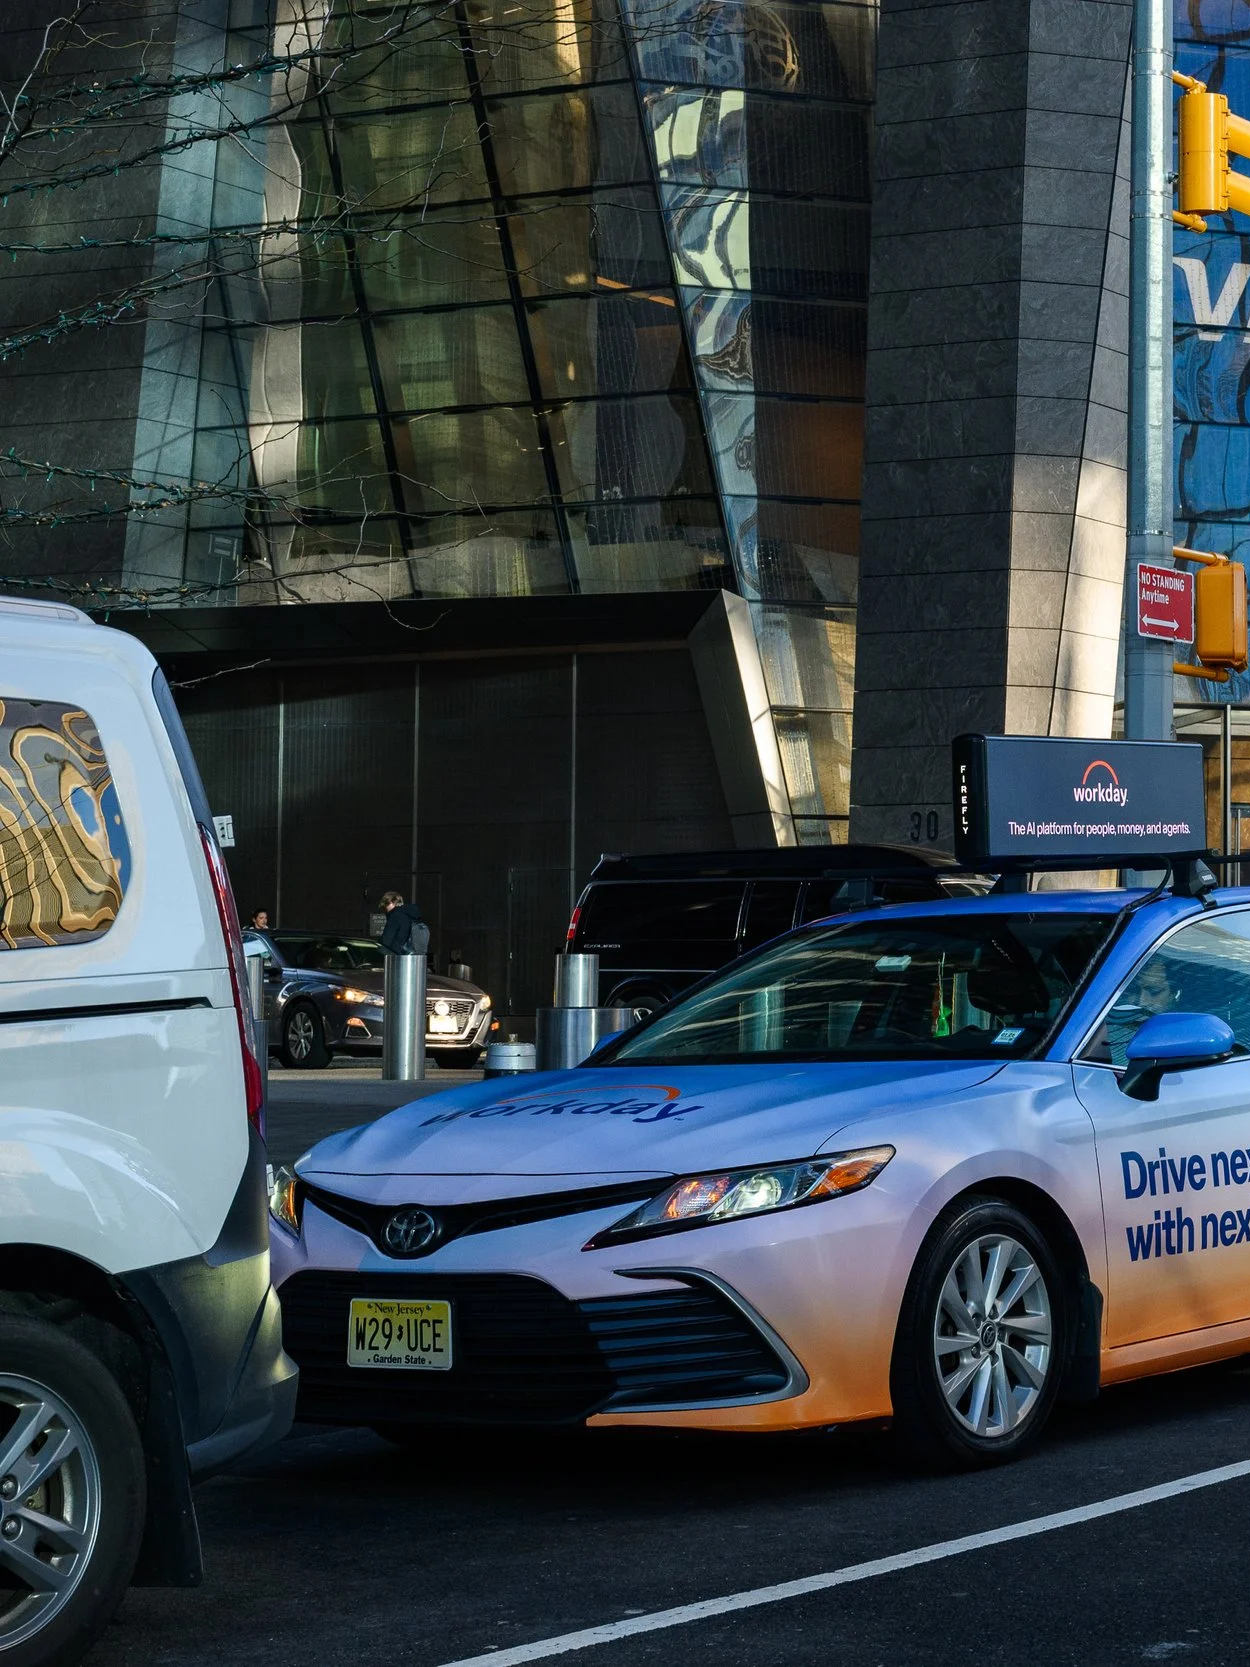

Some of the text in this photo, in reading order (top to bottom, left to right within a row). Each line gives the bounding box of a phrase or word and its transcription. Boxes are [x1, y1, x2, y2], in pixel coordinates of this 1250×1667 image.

[1141, 572, 1185, 592] NO STANDING
[1141, 590, 1170, 605] Anytime
[960, 765, 969, 834] FIREFLY
[910, 811, 939, 842] 30
[1008, 822, 1191, 838] The AI platform for people, money, and agents.
[417, 1099, 704, 1128] workday
[1120, 1147, 1206, 1200] Drive
[1126, 1207, 1195, 1262] with
[374, 1302, 425, 1316] New Jersey
[355, 1317, 444, 1353] W29 UCE
[373, 1354, 426, 1365] Garden State
